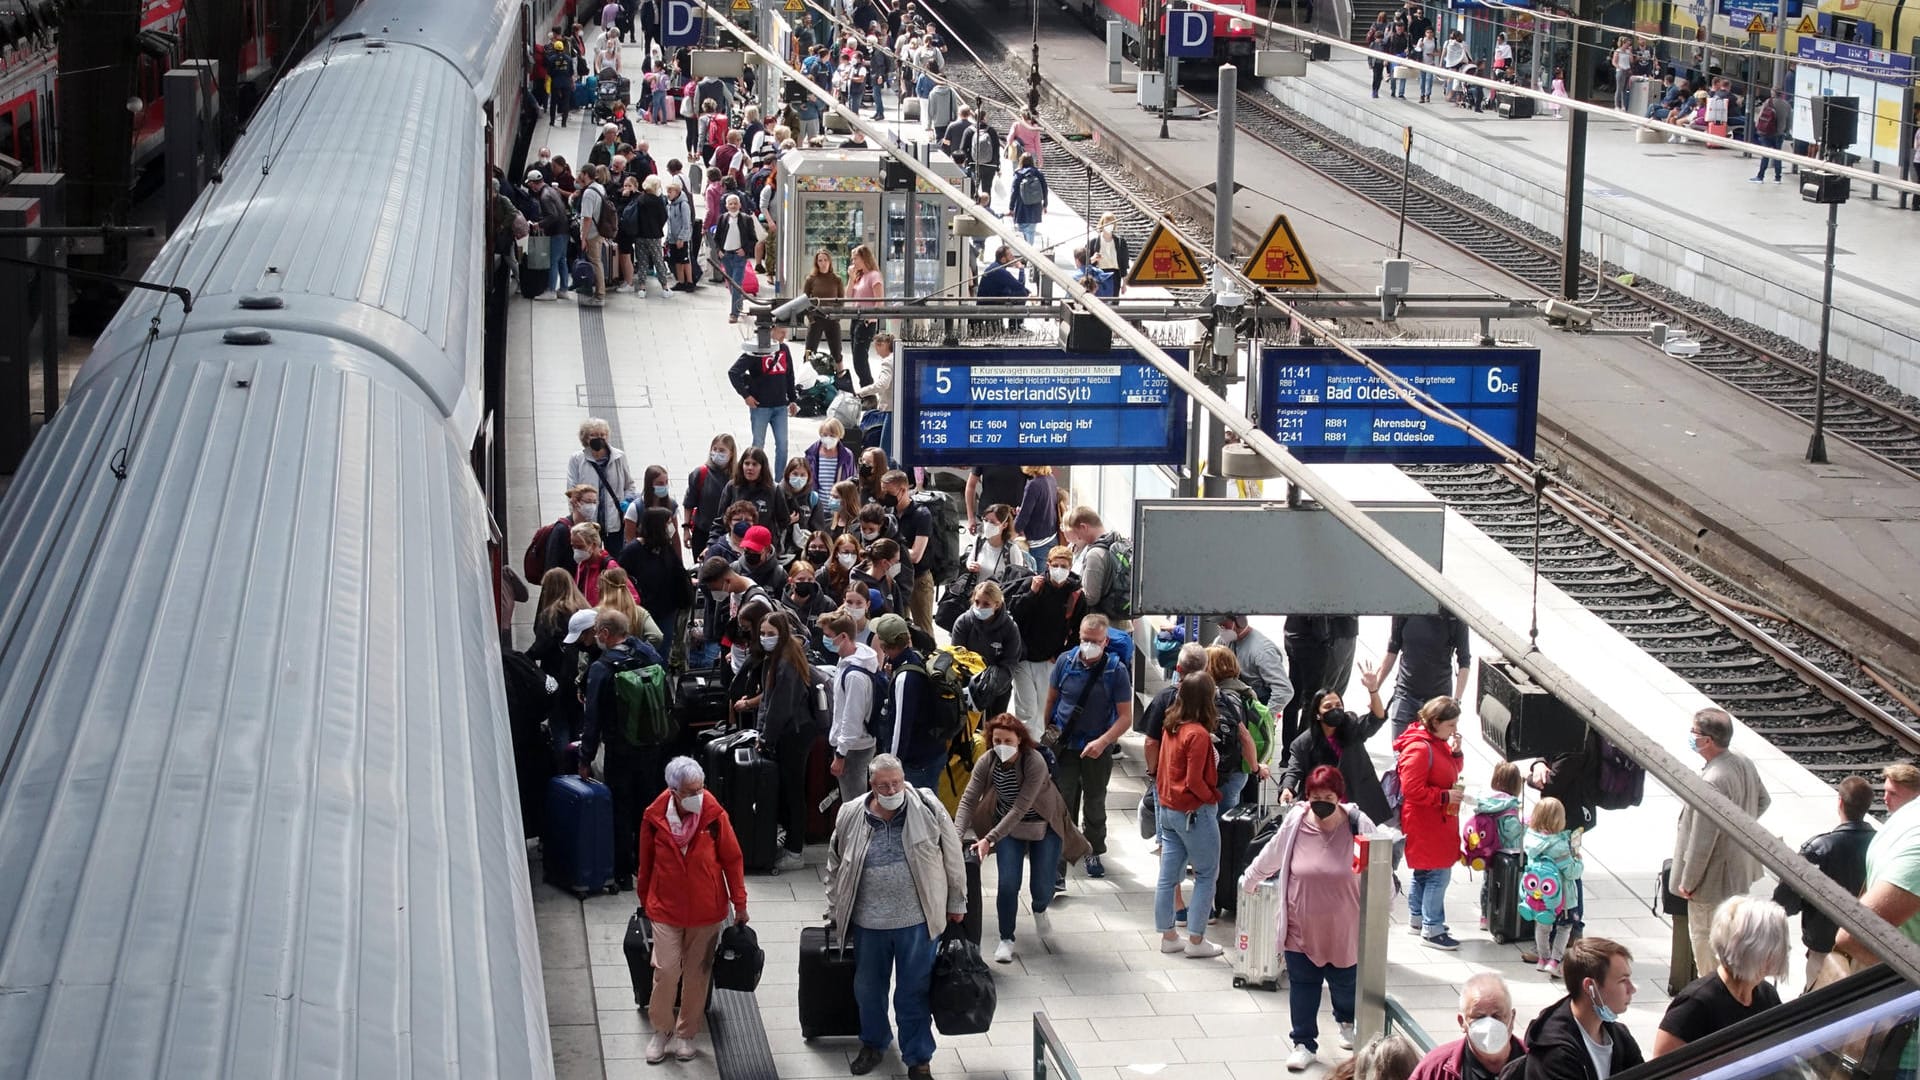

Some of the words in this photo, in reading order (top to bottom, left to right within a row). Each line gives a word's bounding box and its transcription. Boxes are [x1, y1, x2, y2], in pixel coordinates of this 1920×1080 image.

[668, 1, 693, 35] D
[1182, 12, 1208, 47] D
[1030, 367, 1051, 375] nach
[1280, 367, 1311, 378] 11:41
[936, 367, 952, 394] 5
[971, 377, 998, 385] Itzehoe
[1004, 377, 1024, 385] Heide
[1057, 377, 1081, 385] Husum
[1327, 376, 1361, 384] Rahlstedt
[1414, 376, 1456, 385] Bargteheide
[1487, 367, 1502, 393] 6
[1502, 383, 1518, 392] D-E
[971, 386, 1092, 404] Westerland(Sylt)
[1327, 386, 1352, 400] Bad
[920, 420, 947, 430] 11:24
[969, 420, 983, 430] ICE
[987, 420, 1008, 430] 1604
[1019, 422, 1037, 430] von
[1040, 420, 1073, 431] Leipzig
[1076, 420, 1092, 430] Hbf
[1278, 418, 1303, 428] 12:11
[1325, 418, 1347, 428] RB81
[1373, 418, 1426, 430] Ahrensburg
[920, 434, 947, 444] 11:36
[969, 434, 983, 443] ICE
[986, 434, 1002, 443] 707
[1019, 434, 1047, 443] Erfurt
[1050, 434, 1067, 443] Hbf
[1277, 432, 1302, 442] 12:41
[1324, 432, 1347, 441] RB81
[1372, 432, 1391, 441] Bad
[1393, 432, 1434, 441] Oldesloe
